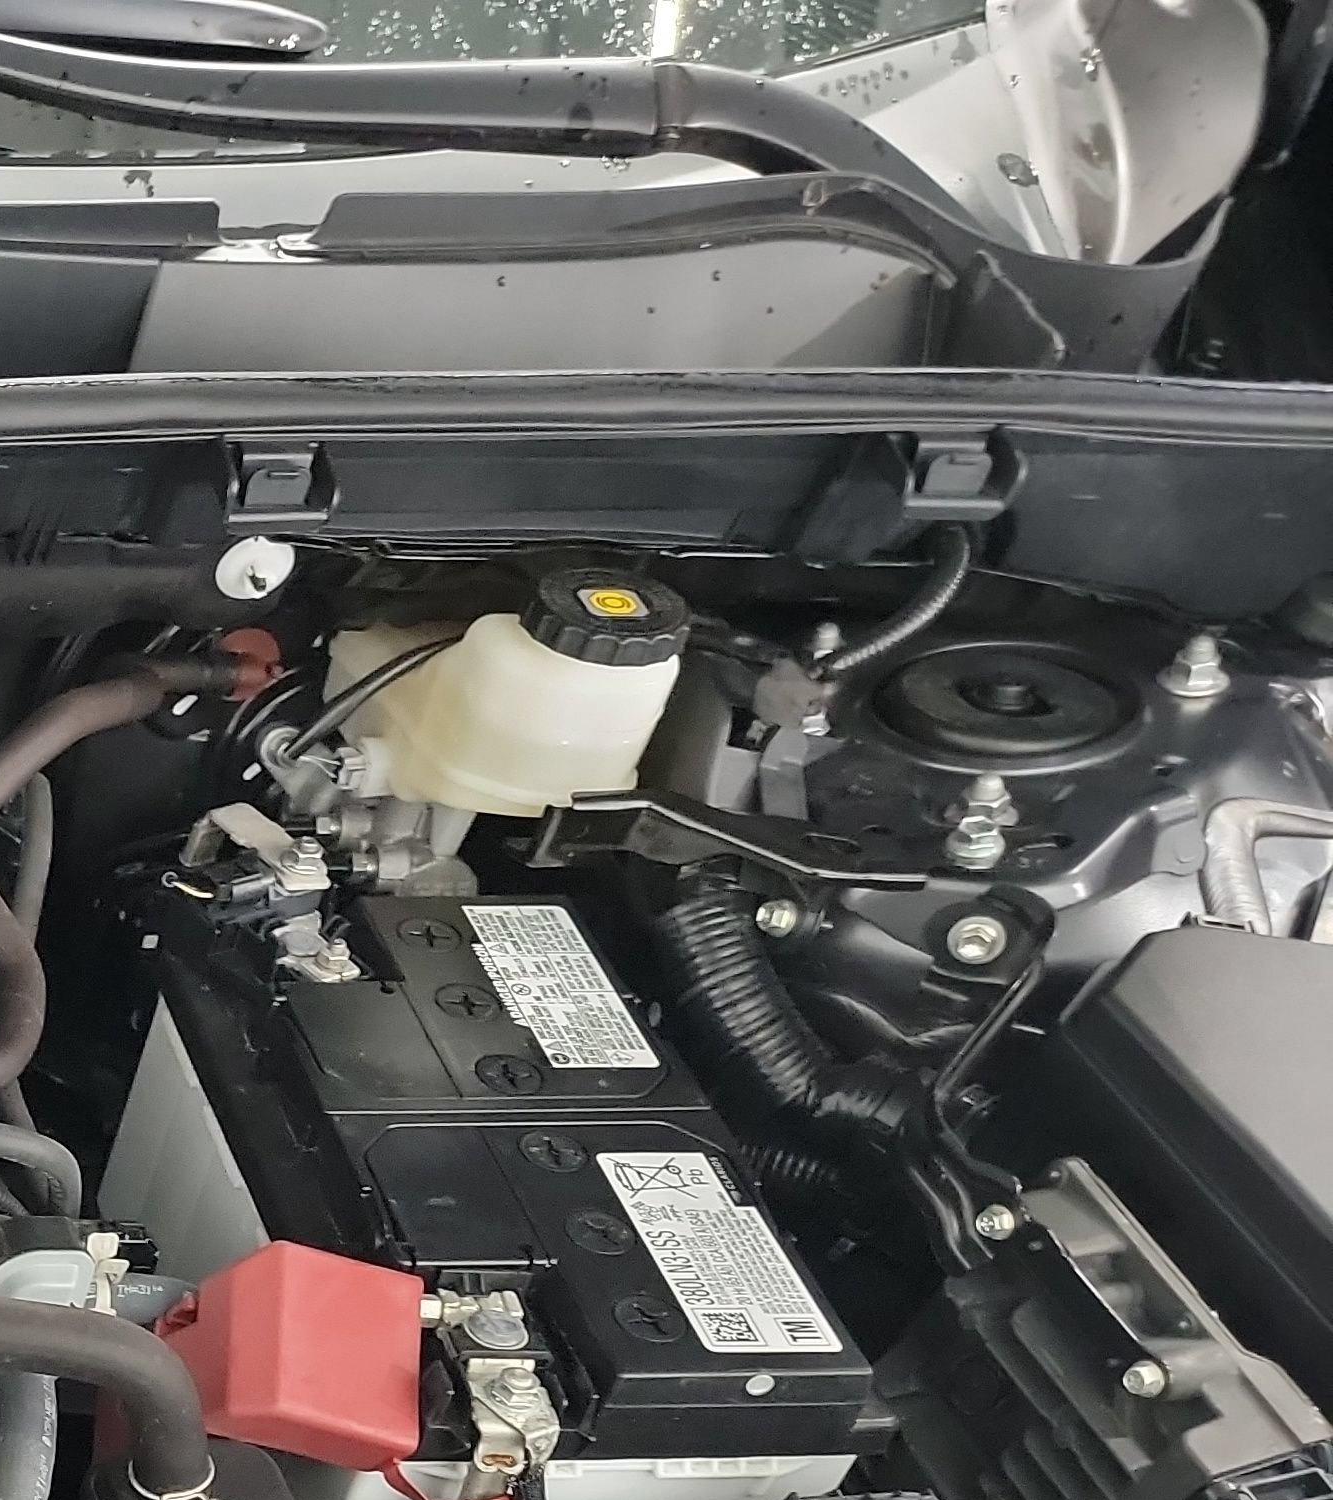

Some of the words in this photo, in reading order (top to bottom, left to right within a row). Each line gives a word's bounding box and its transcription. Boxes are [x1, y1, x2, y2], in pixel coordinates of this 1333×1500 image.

[687, 1168, 710, 1185] Pb
[644, 1230, 715, 1306] 380LN3-ISS
[781, 1321, 824, 1342] TM
